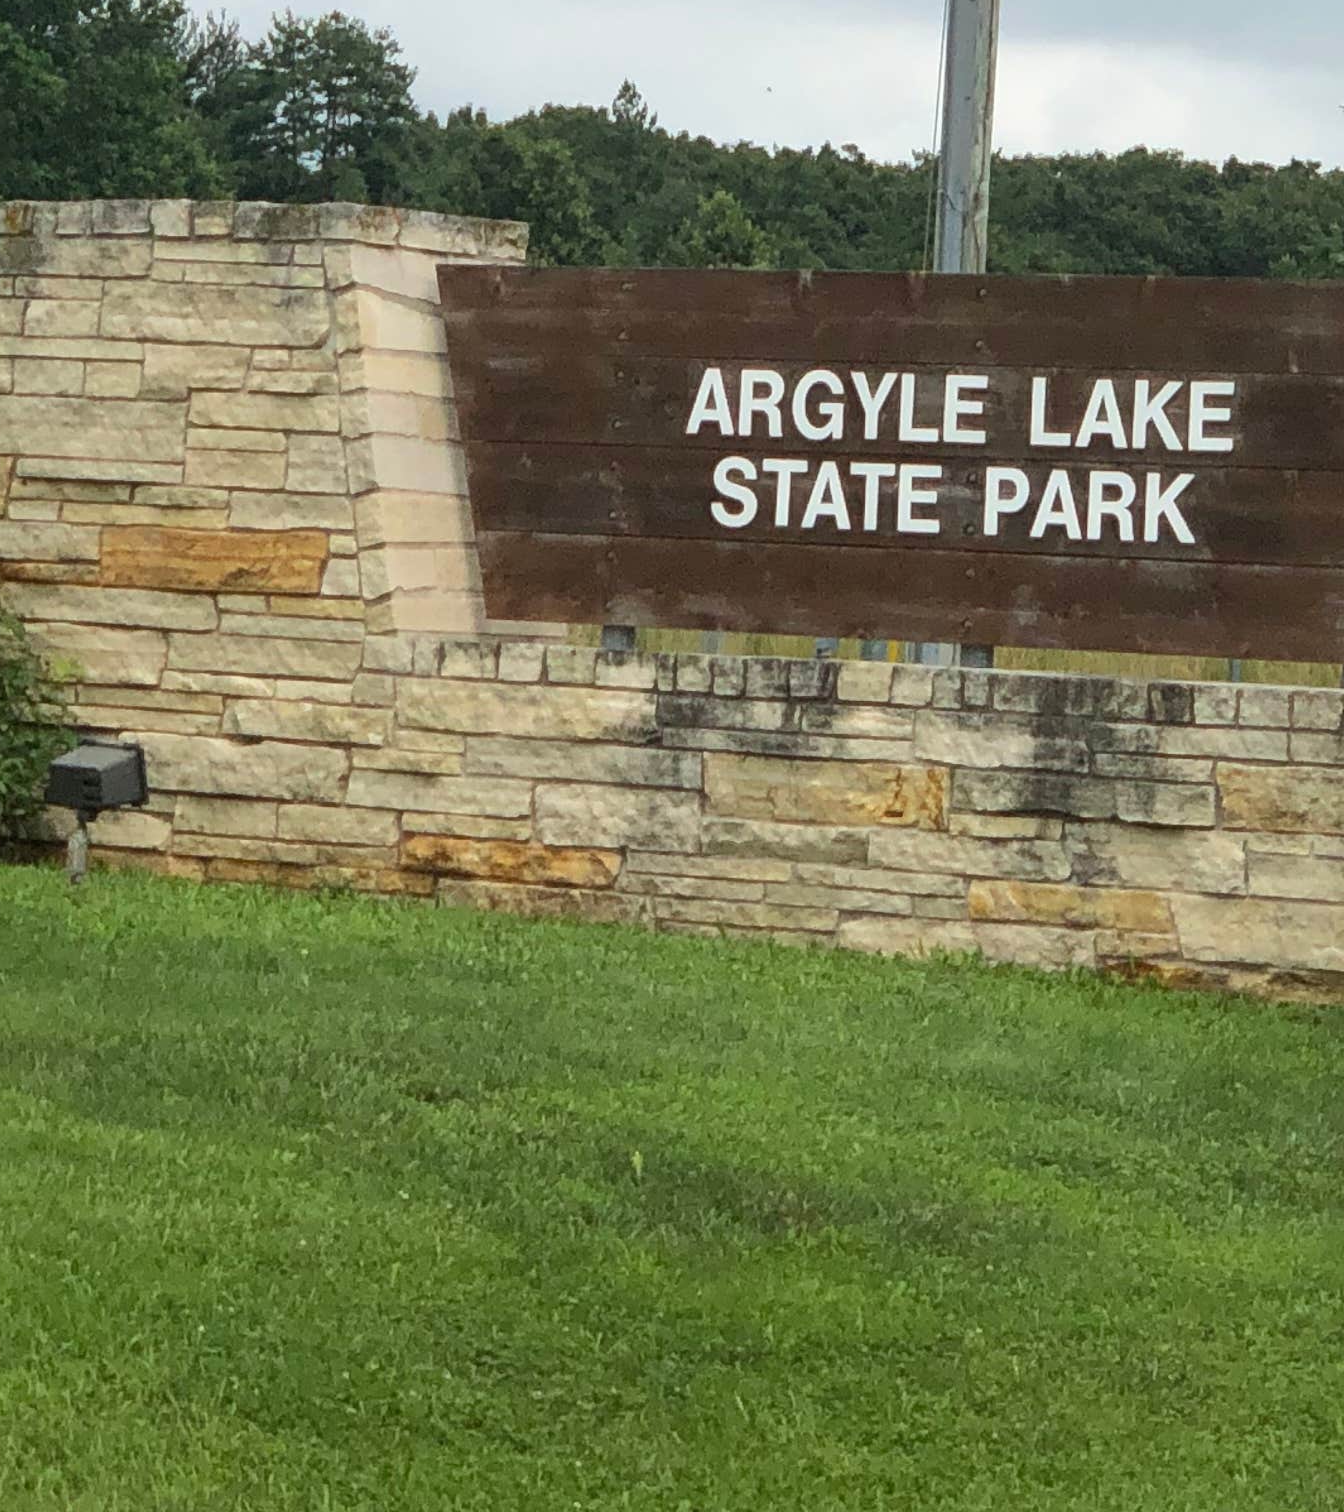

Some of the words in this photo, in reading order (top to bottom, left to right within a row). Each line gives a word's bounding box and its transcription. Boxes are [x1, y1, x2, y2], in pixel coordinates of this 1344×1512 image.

[685, 367, 989, 445] ARGYLE
[1029, 375, 1236, 453] LAKE
[709, 455, 943, 534] STATE
[982, 465, 1197, 544] PARK
